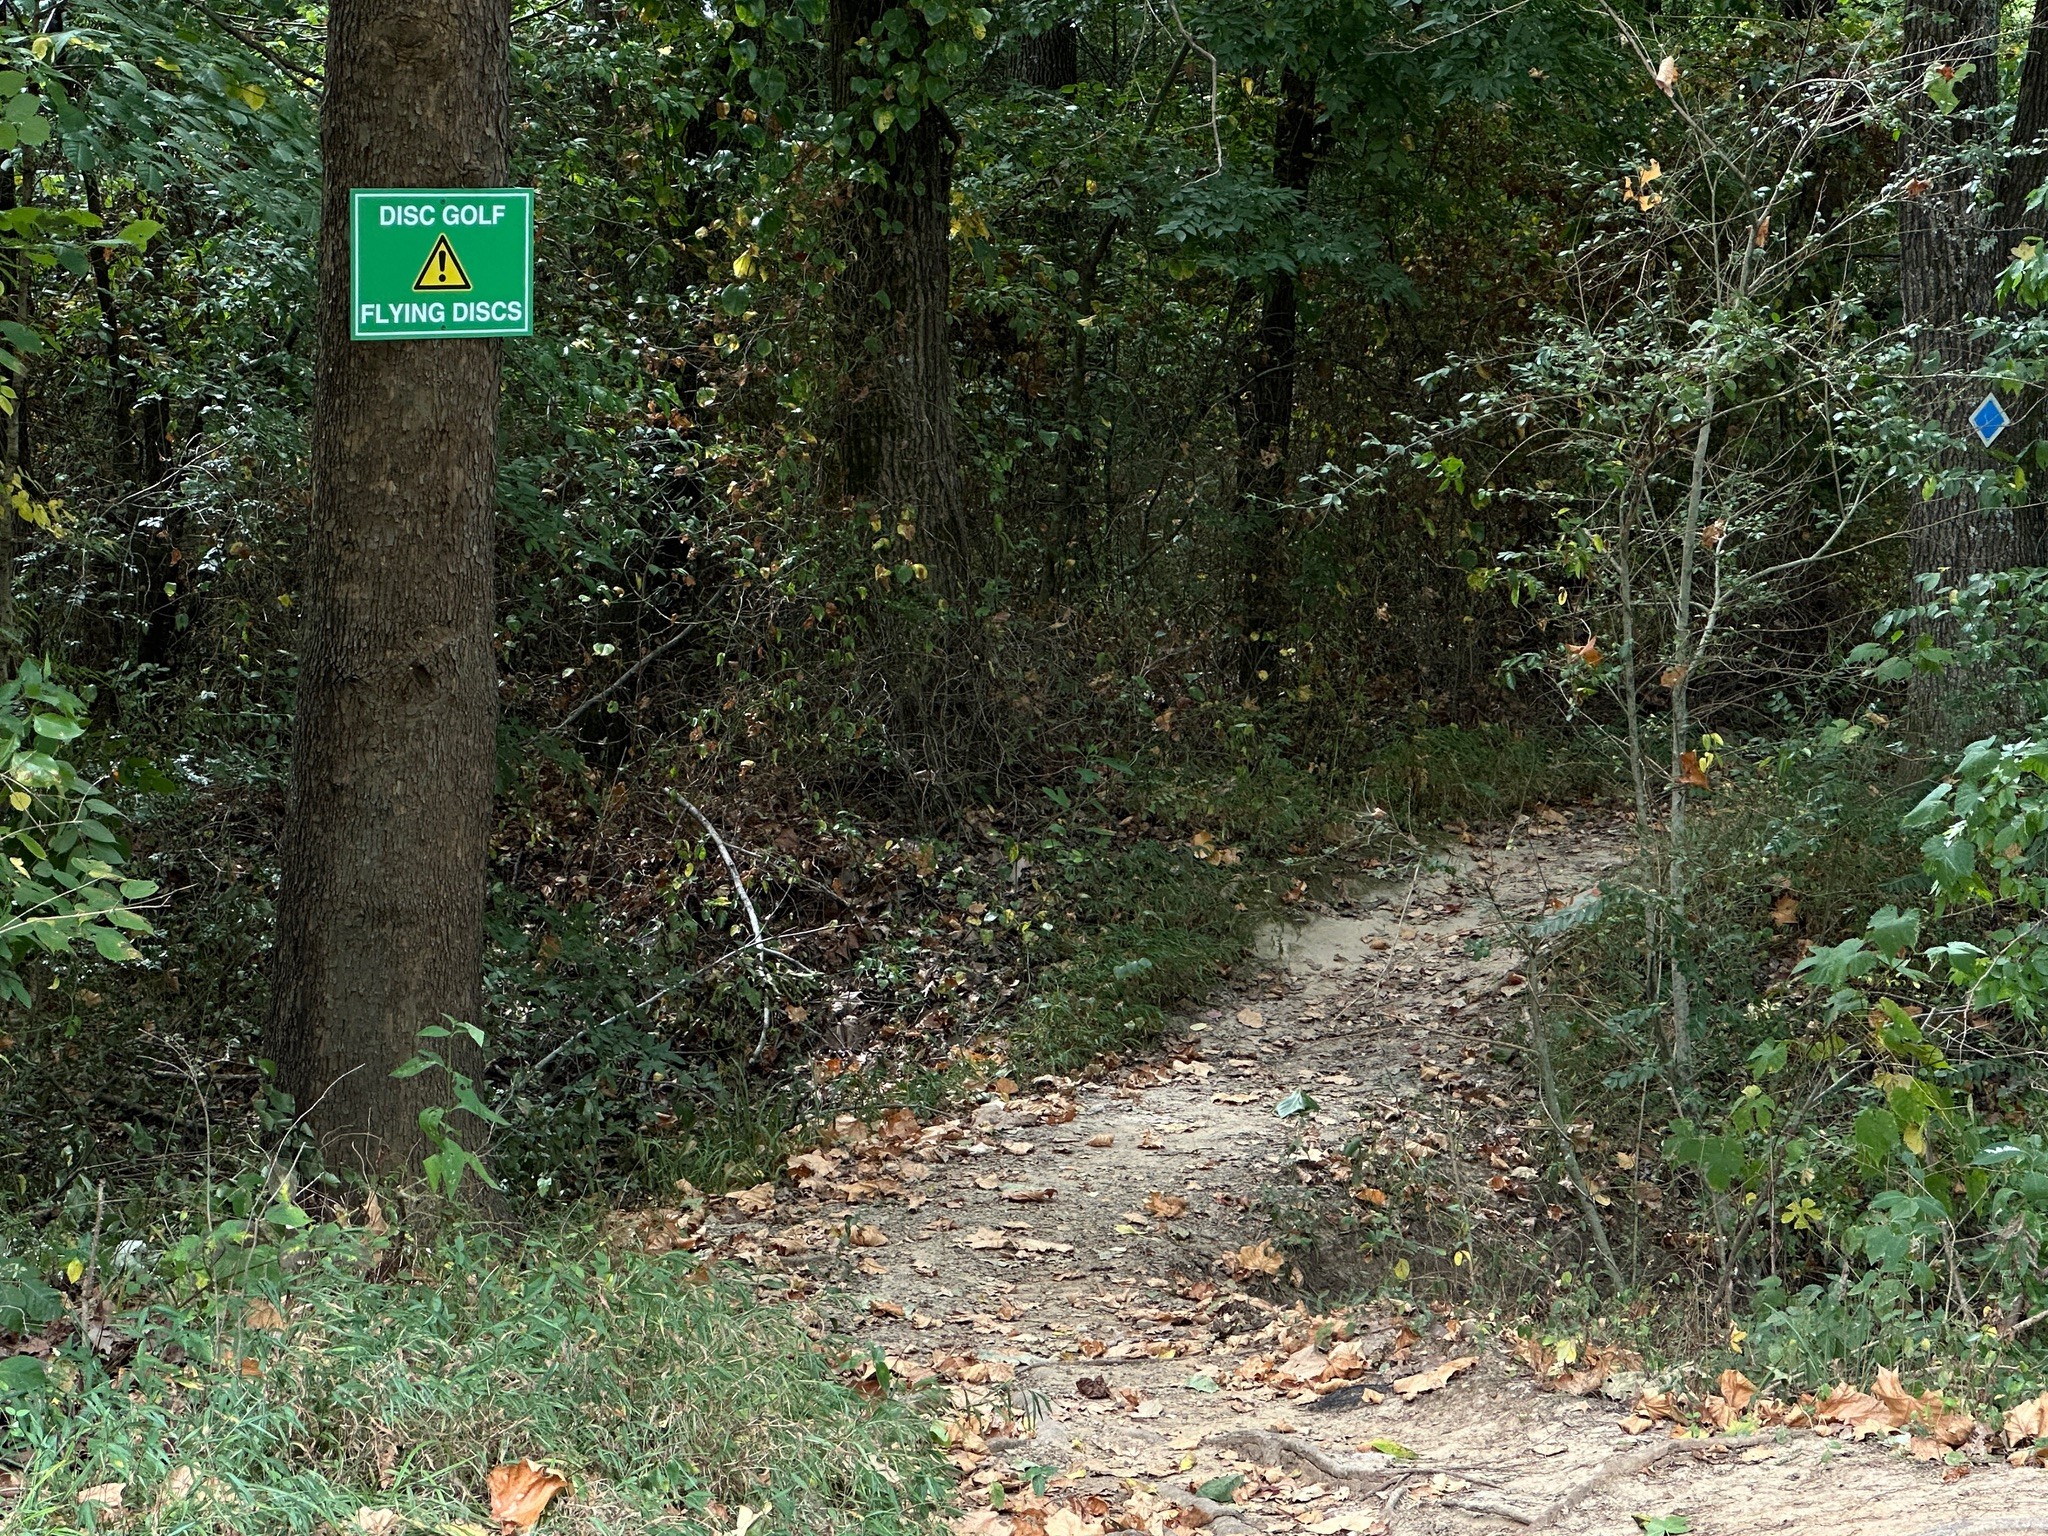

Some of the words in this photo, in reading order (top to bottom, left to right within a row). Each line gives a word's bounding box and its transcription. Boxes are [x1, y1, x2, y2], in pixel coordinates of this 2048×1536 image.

[379, 205, 436, 226] DISC
[442, 204, 506, 225] GOLF
[361, 302, 445, 324] FLYING
[452, 301, 522, 323] DISCS
